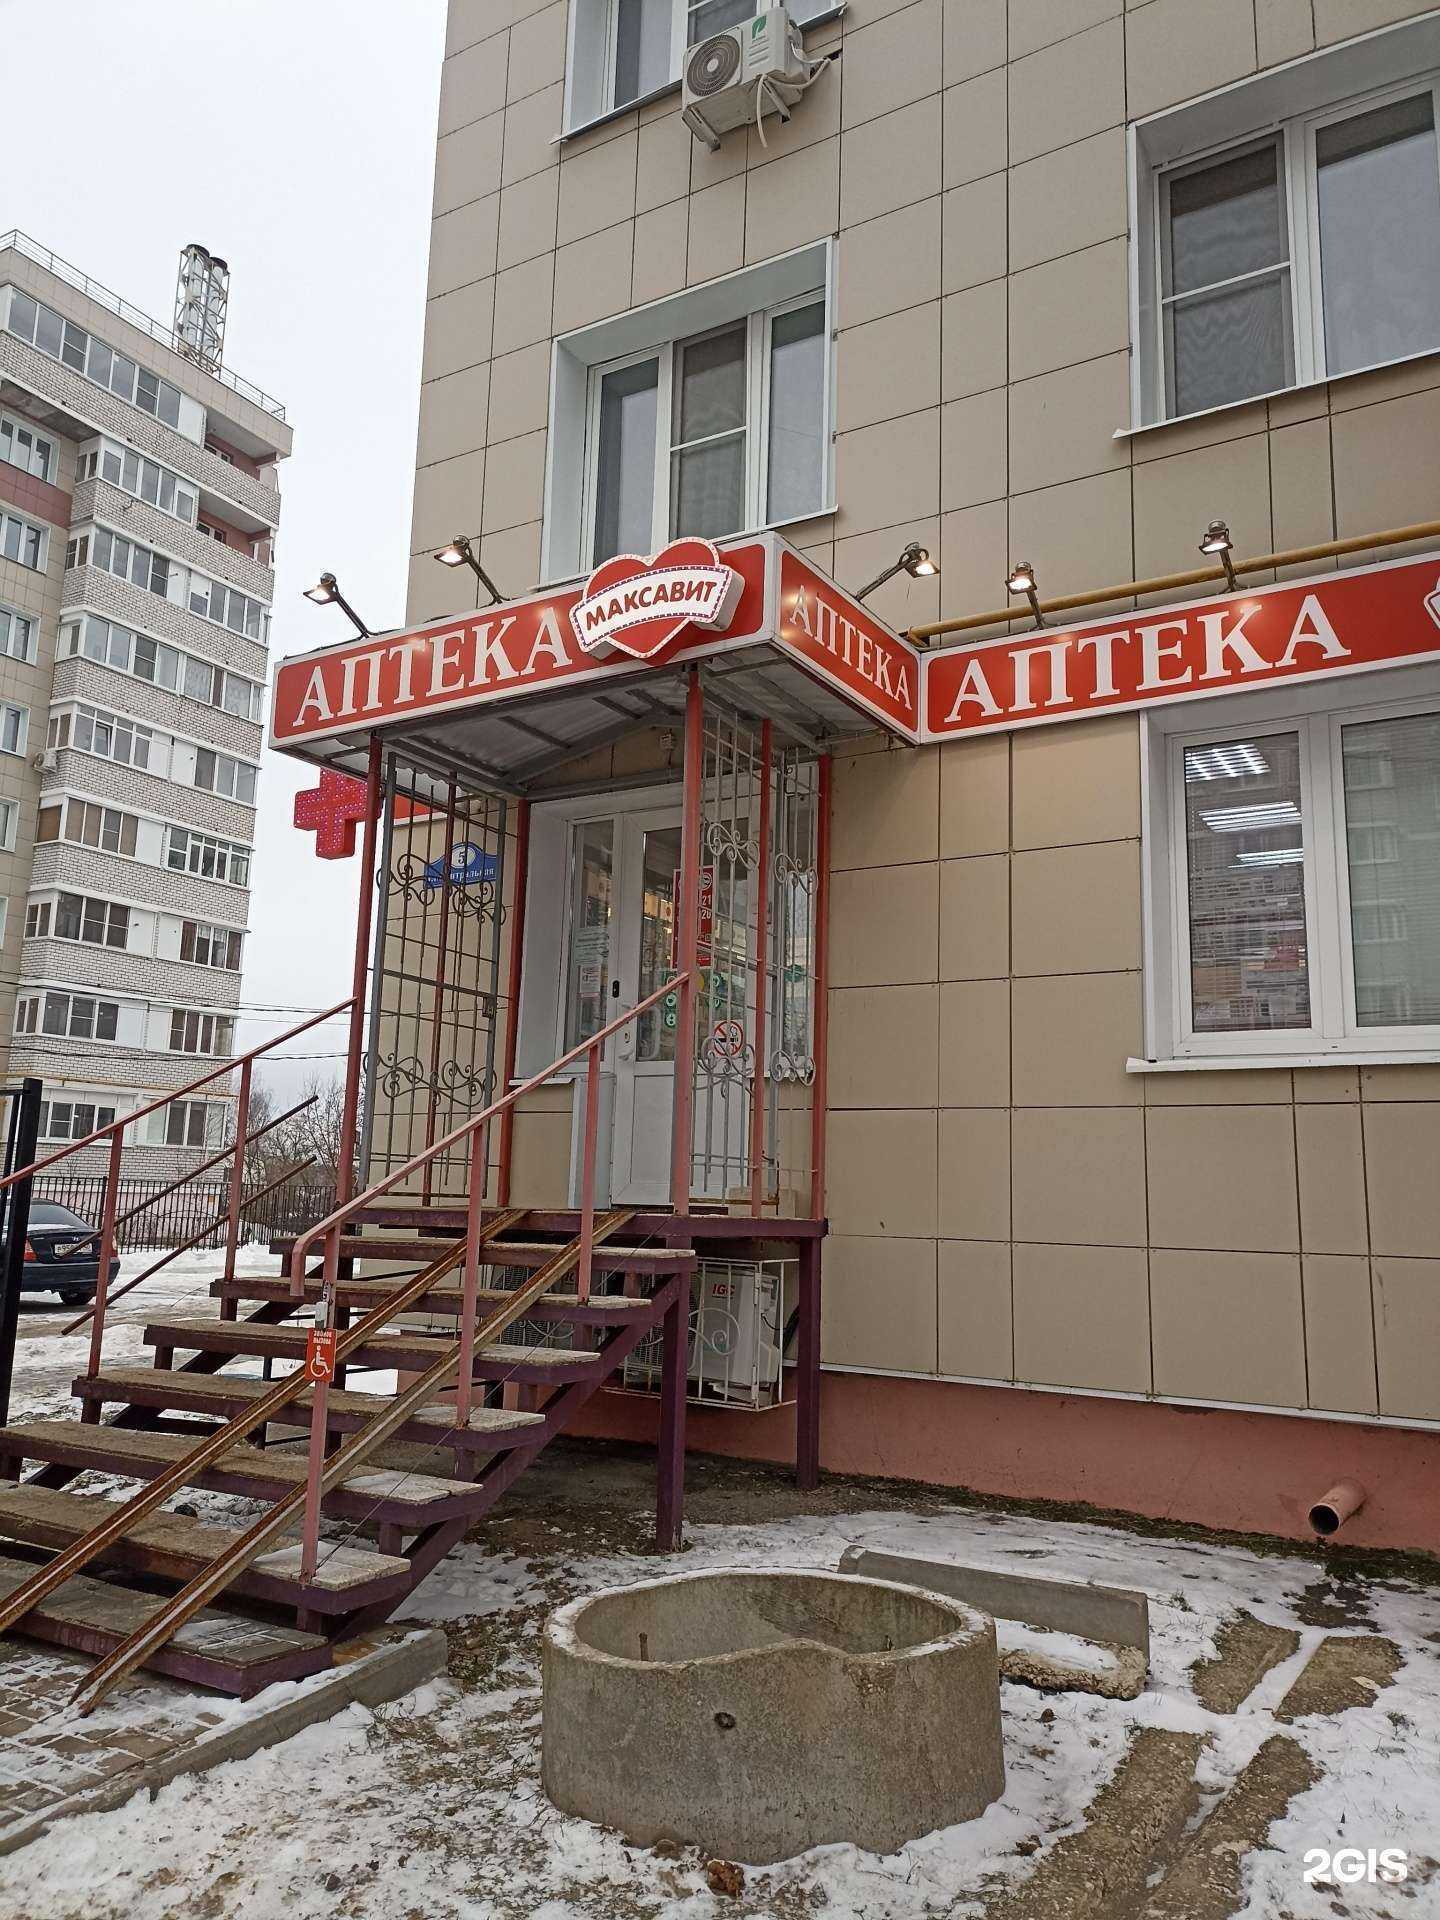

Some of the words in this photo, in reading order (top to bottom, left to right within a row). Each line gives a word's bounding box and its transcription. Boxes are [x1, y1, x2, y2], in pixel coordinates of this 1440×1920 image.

[292, 607, 574, 727] АПТЕКА
[585, 580, 717, 632] МАКСАВИТ
[788, 585, 913, 713] АПТЕКА
[944, 594, 1352, 723] АПТЕКА
